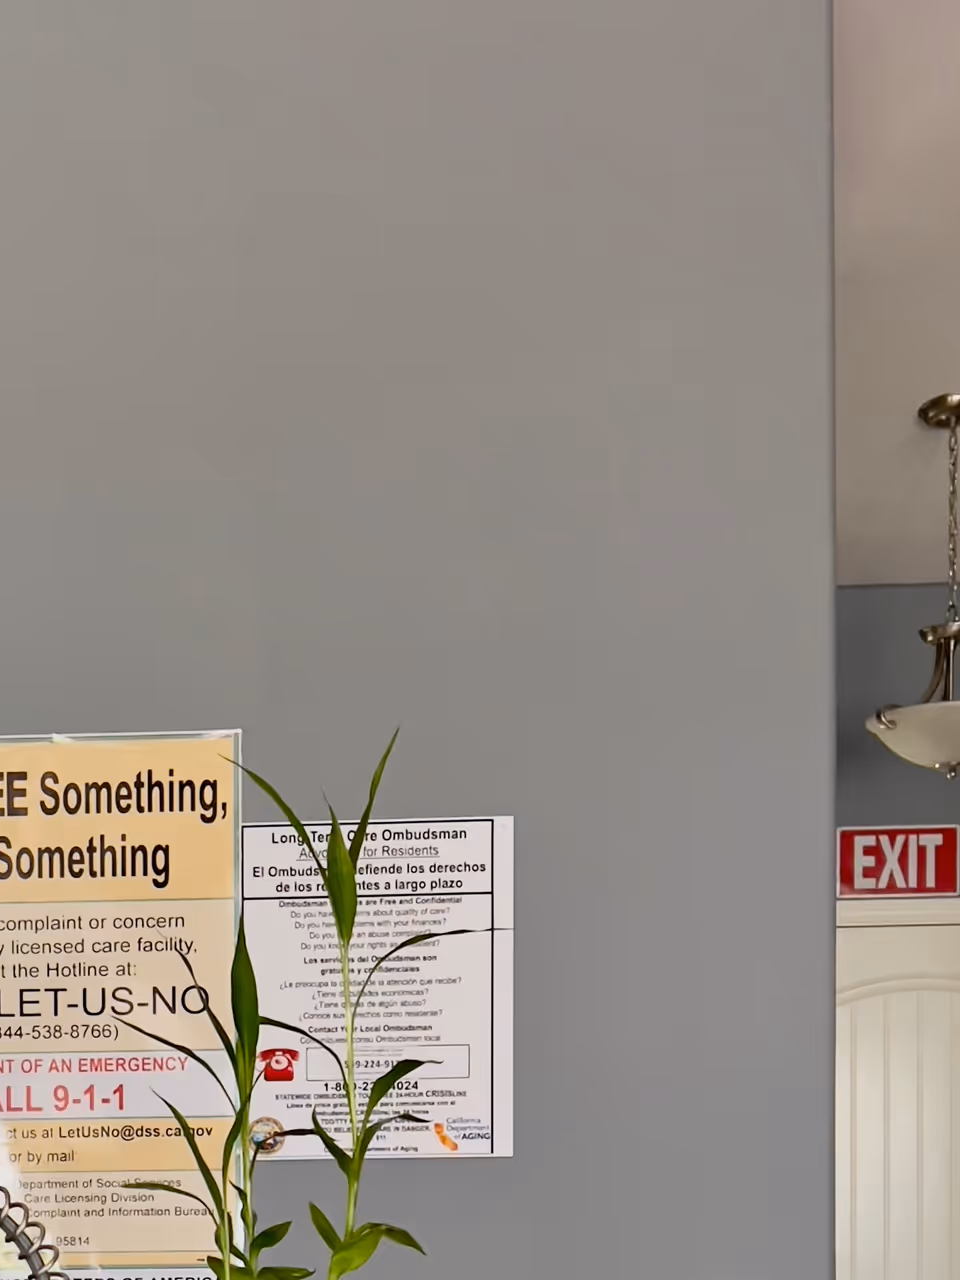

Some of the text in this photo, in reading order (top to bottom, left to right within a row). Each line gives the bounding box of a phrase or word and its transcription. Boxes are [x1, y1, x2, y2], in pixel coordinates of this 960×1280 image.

[39, 768, 228, 824] Something,
[346, 829, 377, 842] Cre
[381, 827, 467, 841] Ombudsman
[362, 844, 439, 857] for Residents
[853, 832, 944, 890] EXIT
[252, 865, 265, 878] El
[356, 863, 403, 875] efiende
[406, 862, 425, 874] los
[428, 861, 487, 874] derechos
[275, 881, 290, 893] de
[294, 880, 313, 892] los
[384, 881, 391, 890] a
[395, 879, 427, 892] largo
[430, 877, 463, 891] plazo
[88, 917, 107, 930] or
[112, 914, 185, 930] concern
[10, 938, 85, 955] licensed
[91, 940, 131, 954] care
[136, 937, 198, 956] facility,
[12, 963, 40, 979] the
[46, 962, 109, 979] Hotline
[115, 962, 138, 977] at:
[307, 1025, 339, 1034] Contact
[360, 1024, 381, 1033] Local
[21, 1058, 44, 1074] OF
[48, 1057, 73, 1074] AN
[78, 1056, 189, 1073] EMERGENCY
[52, 1083, 126, 1112] 9-1-1
[21, 1128, 37, 1139] us
[41, 1127, 54, 1139] at
[58, 1124, 213, 1142] LetUsNo@dss.cagov
[461, 1132, 491, 1140] AGING
[9, 1149, 75, 1165] or by mail
[82, 1178, 93, 1189] of
[24, 1192, 155, 1205] Care Licensing Division
[83, 1206, 105, 1217] and
[108, 1206, 171, 1218] Information
[56, 1235, 90, 1247] 95814
